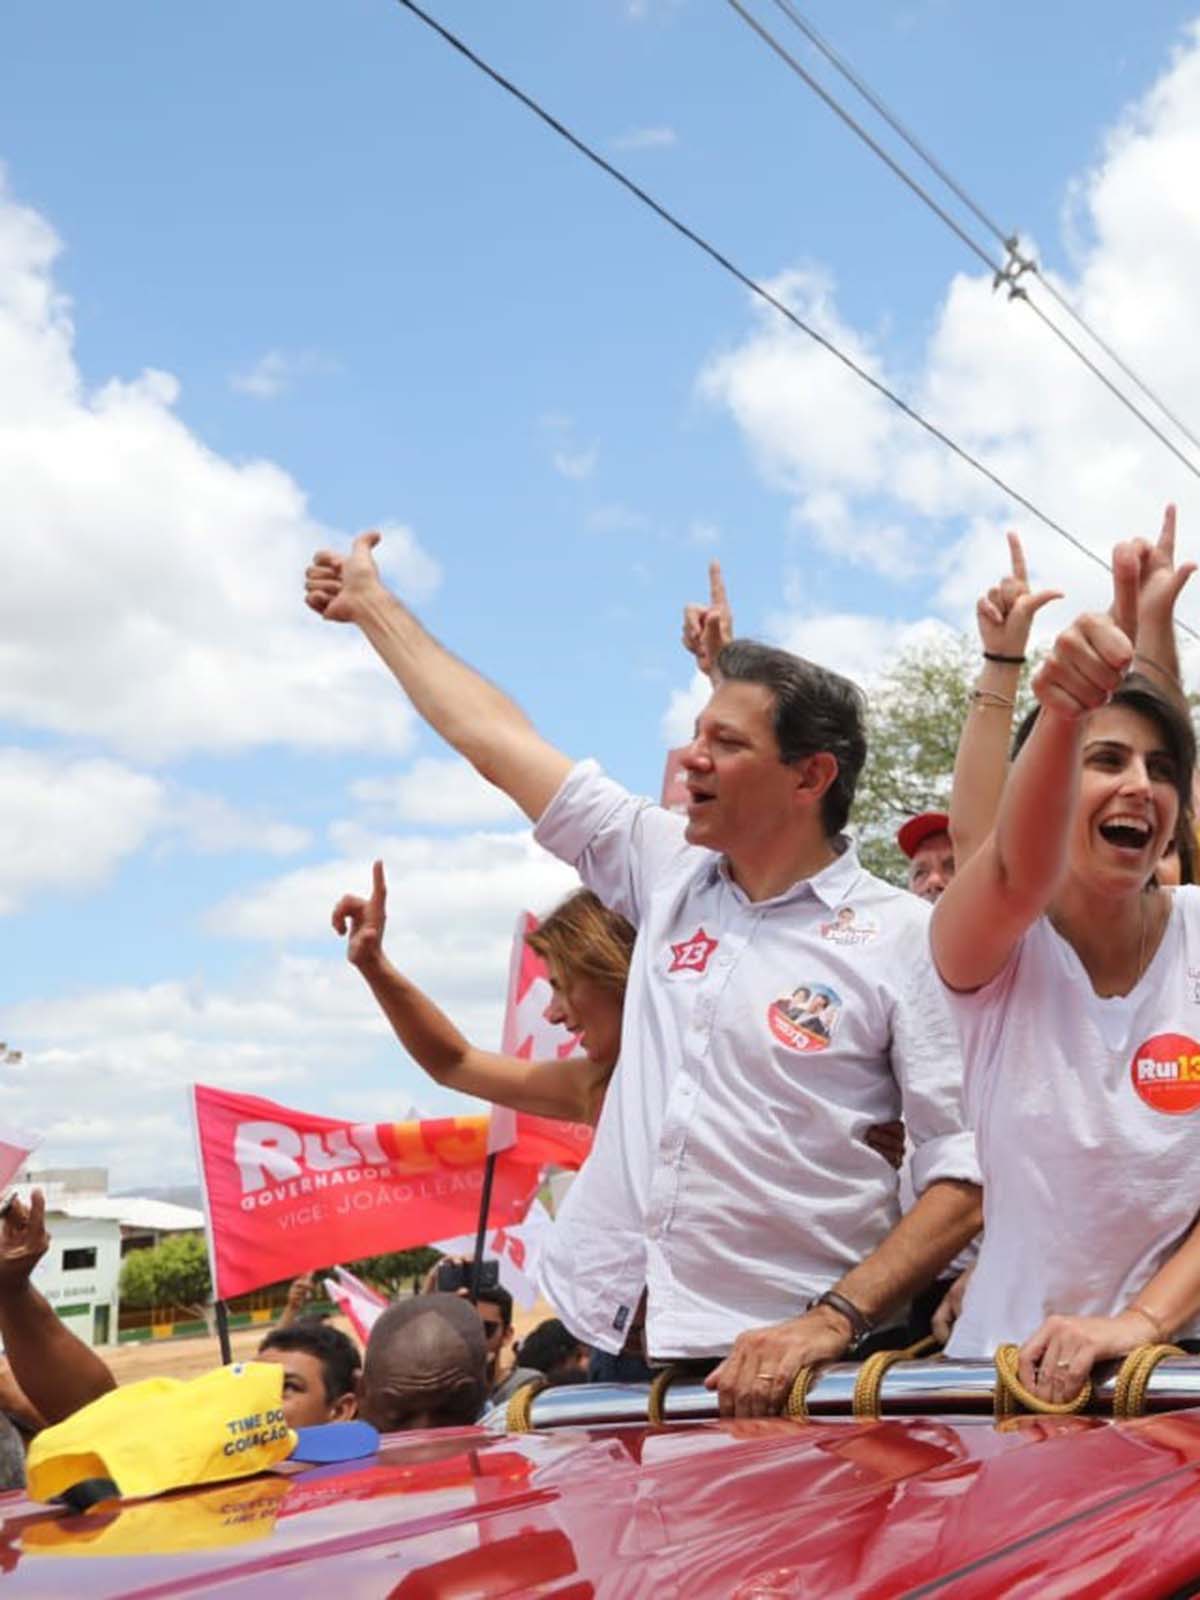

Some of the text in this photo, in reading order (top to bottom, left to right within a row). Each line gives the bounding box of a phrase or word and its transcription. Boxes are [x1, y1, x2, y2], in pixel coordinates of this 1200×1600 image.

[239, 1167, 392, 1212] GOVERNADOR
[226, 1408, 285, 1435] TIME DO
